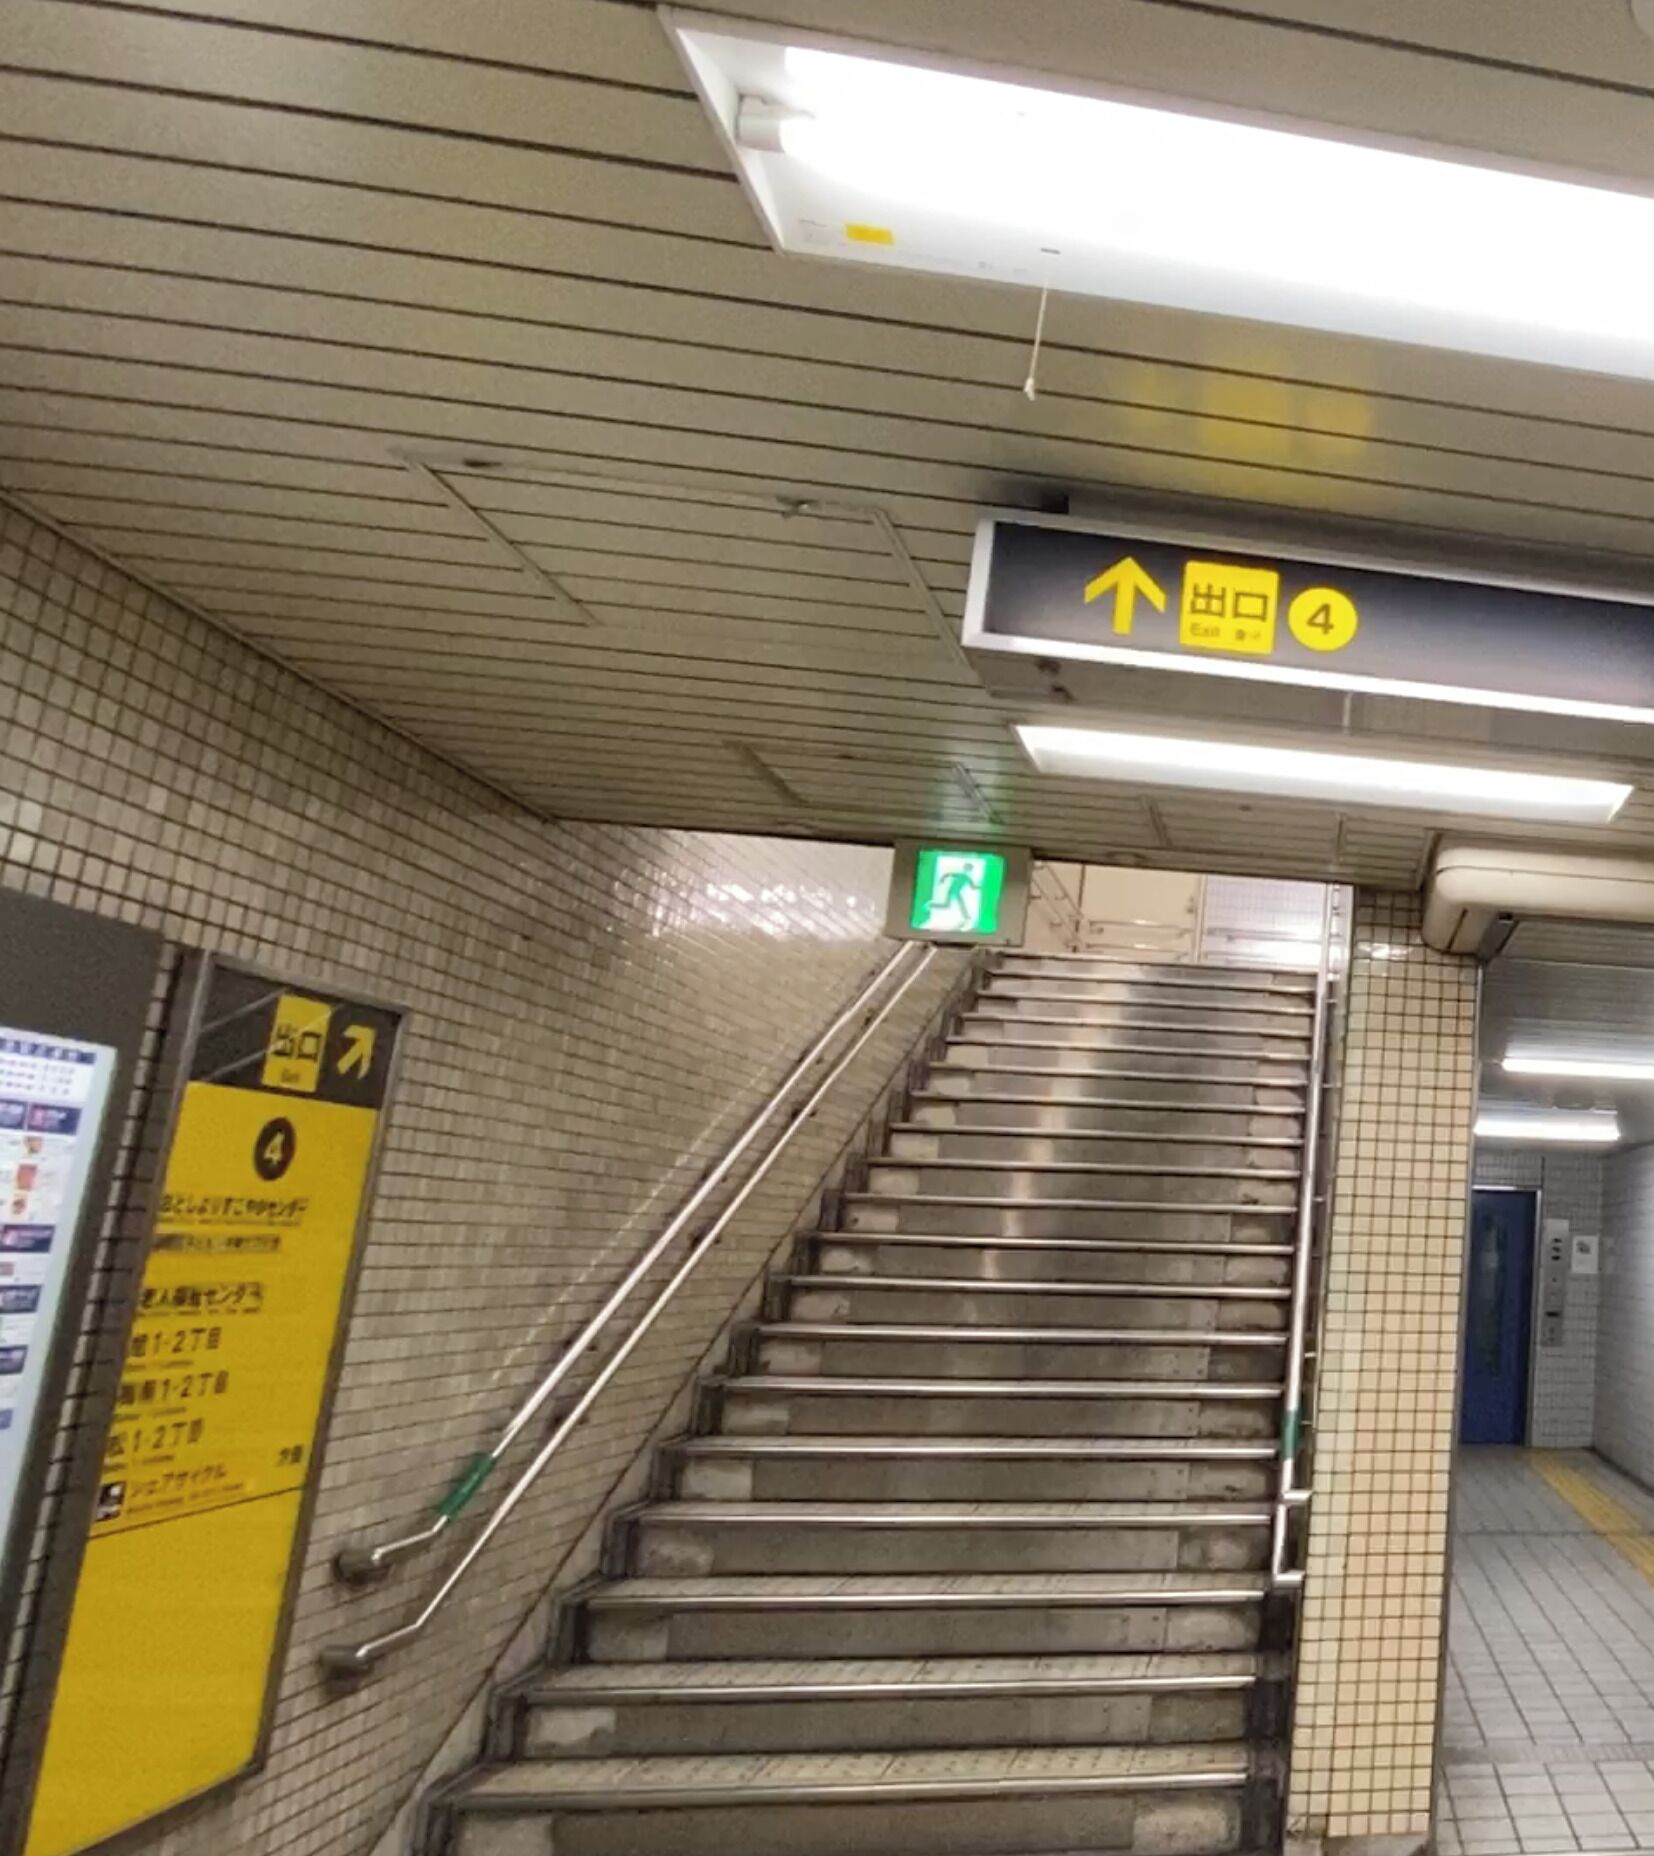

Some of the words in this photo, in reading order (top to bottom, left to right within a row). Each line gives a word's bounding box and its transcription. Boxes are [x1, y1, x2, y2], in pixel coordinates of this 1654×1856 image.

[1189, 582, 1269, 622] 出口
[1305, 602, 1335, 636] 4
[1189, 622, 1221, 638] Exit
[272, 1022, 322, 1062] 出口
[262, 1130, 286, 1166] 4
